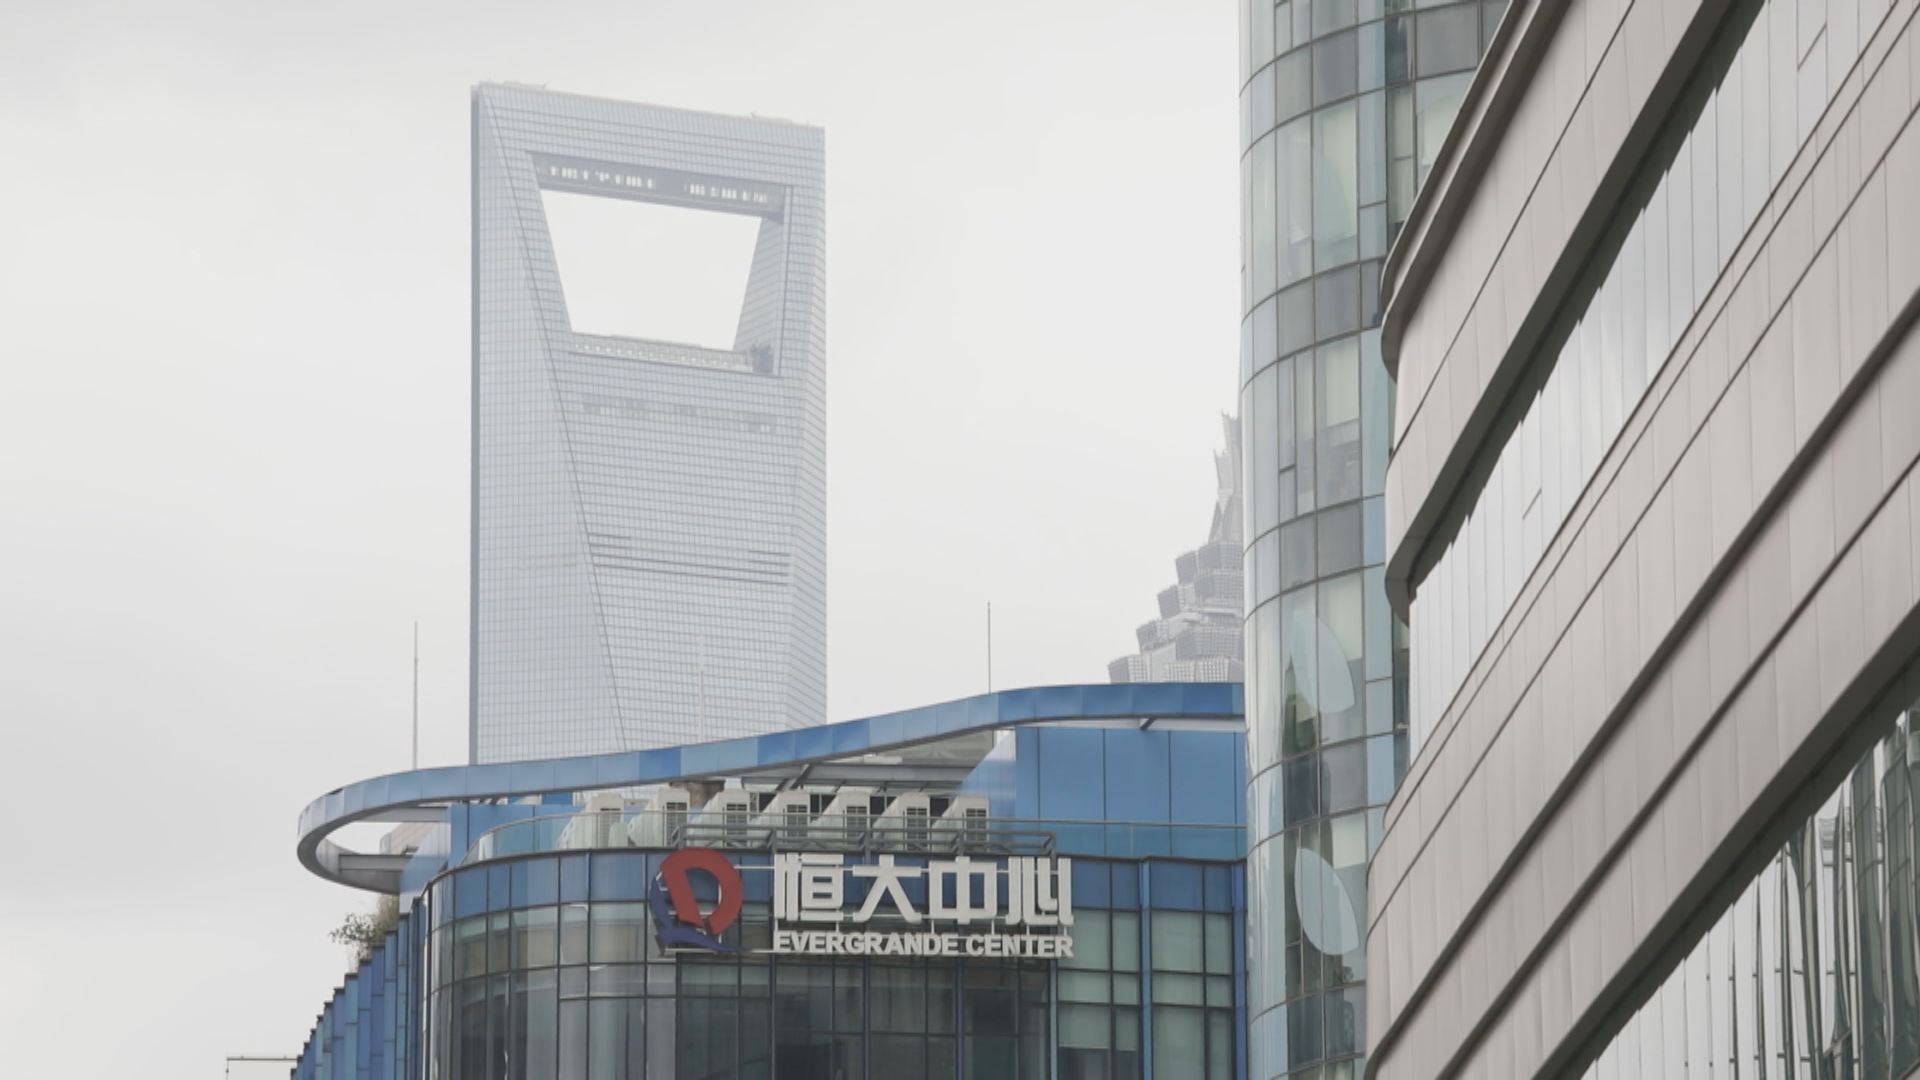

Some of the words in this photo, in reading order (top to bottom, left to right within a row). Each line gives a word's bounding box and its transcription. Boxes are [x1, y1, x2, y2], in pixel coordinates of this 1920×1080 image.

[773, 853, 1074, 925] 恒大中心
[773, 931, 959, 956] EVERGRANDE
[966, 933, 1074, 957] CENTER
